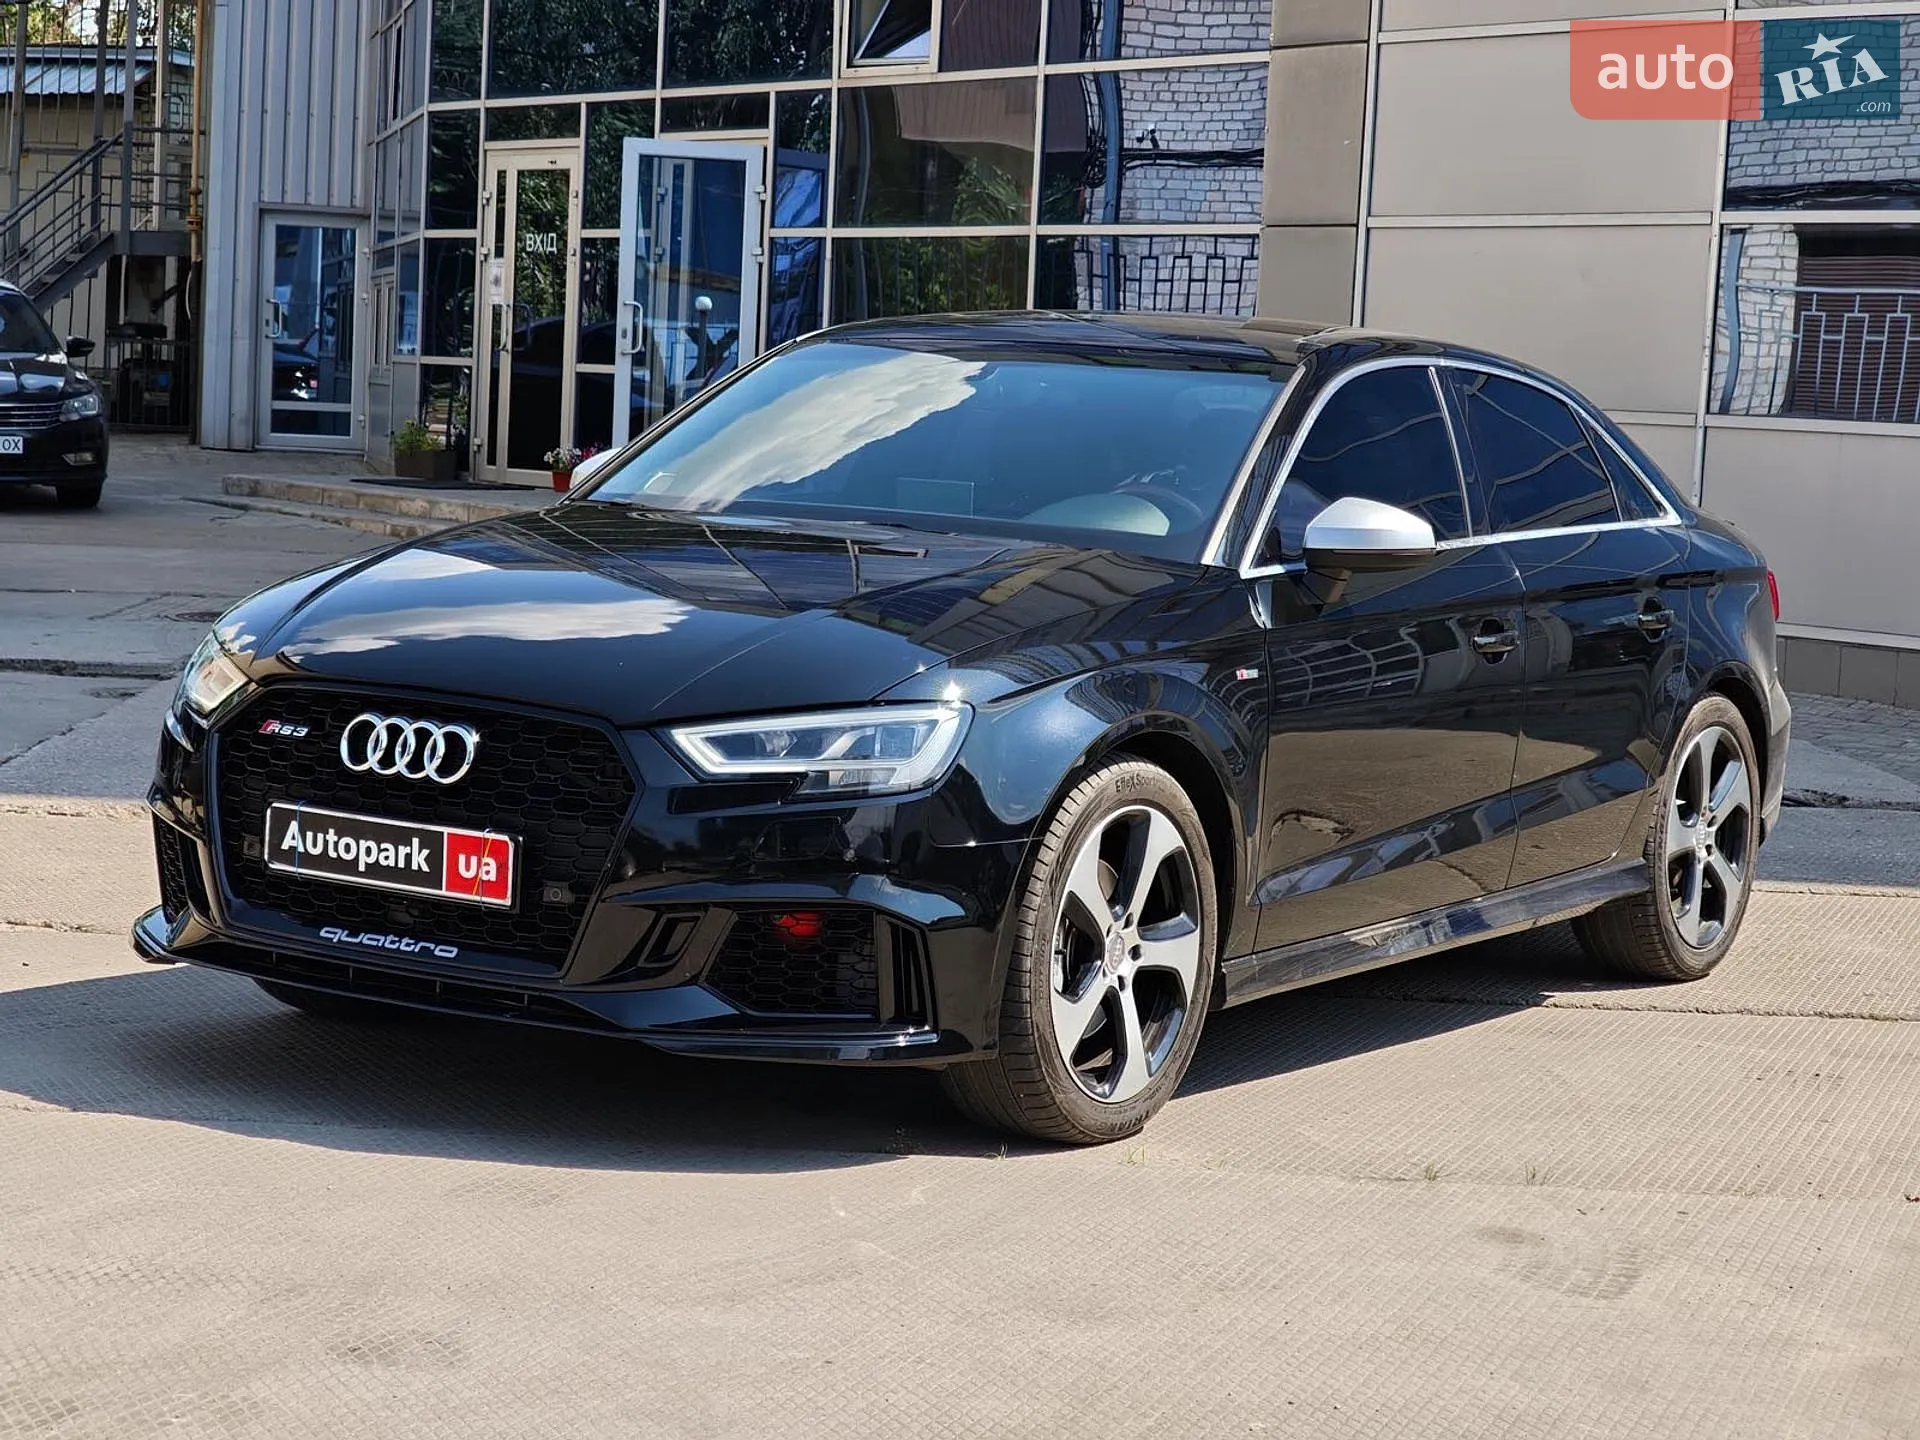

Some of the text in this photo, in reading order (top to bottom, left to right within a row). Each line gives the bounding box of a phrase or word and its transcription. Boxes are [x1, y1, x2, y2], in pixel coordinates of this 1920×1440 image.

[525, 232, 557, 254] ВХІД
[260, 719, 308, 737] RS3
[280, 820, 497, 882] Autopark ua
[319, 926, 459, 959] quattro
